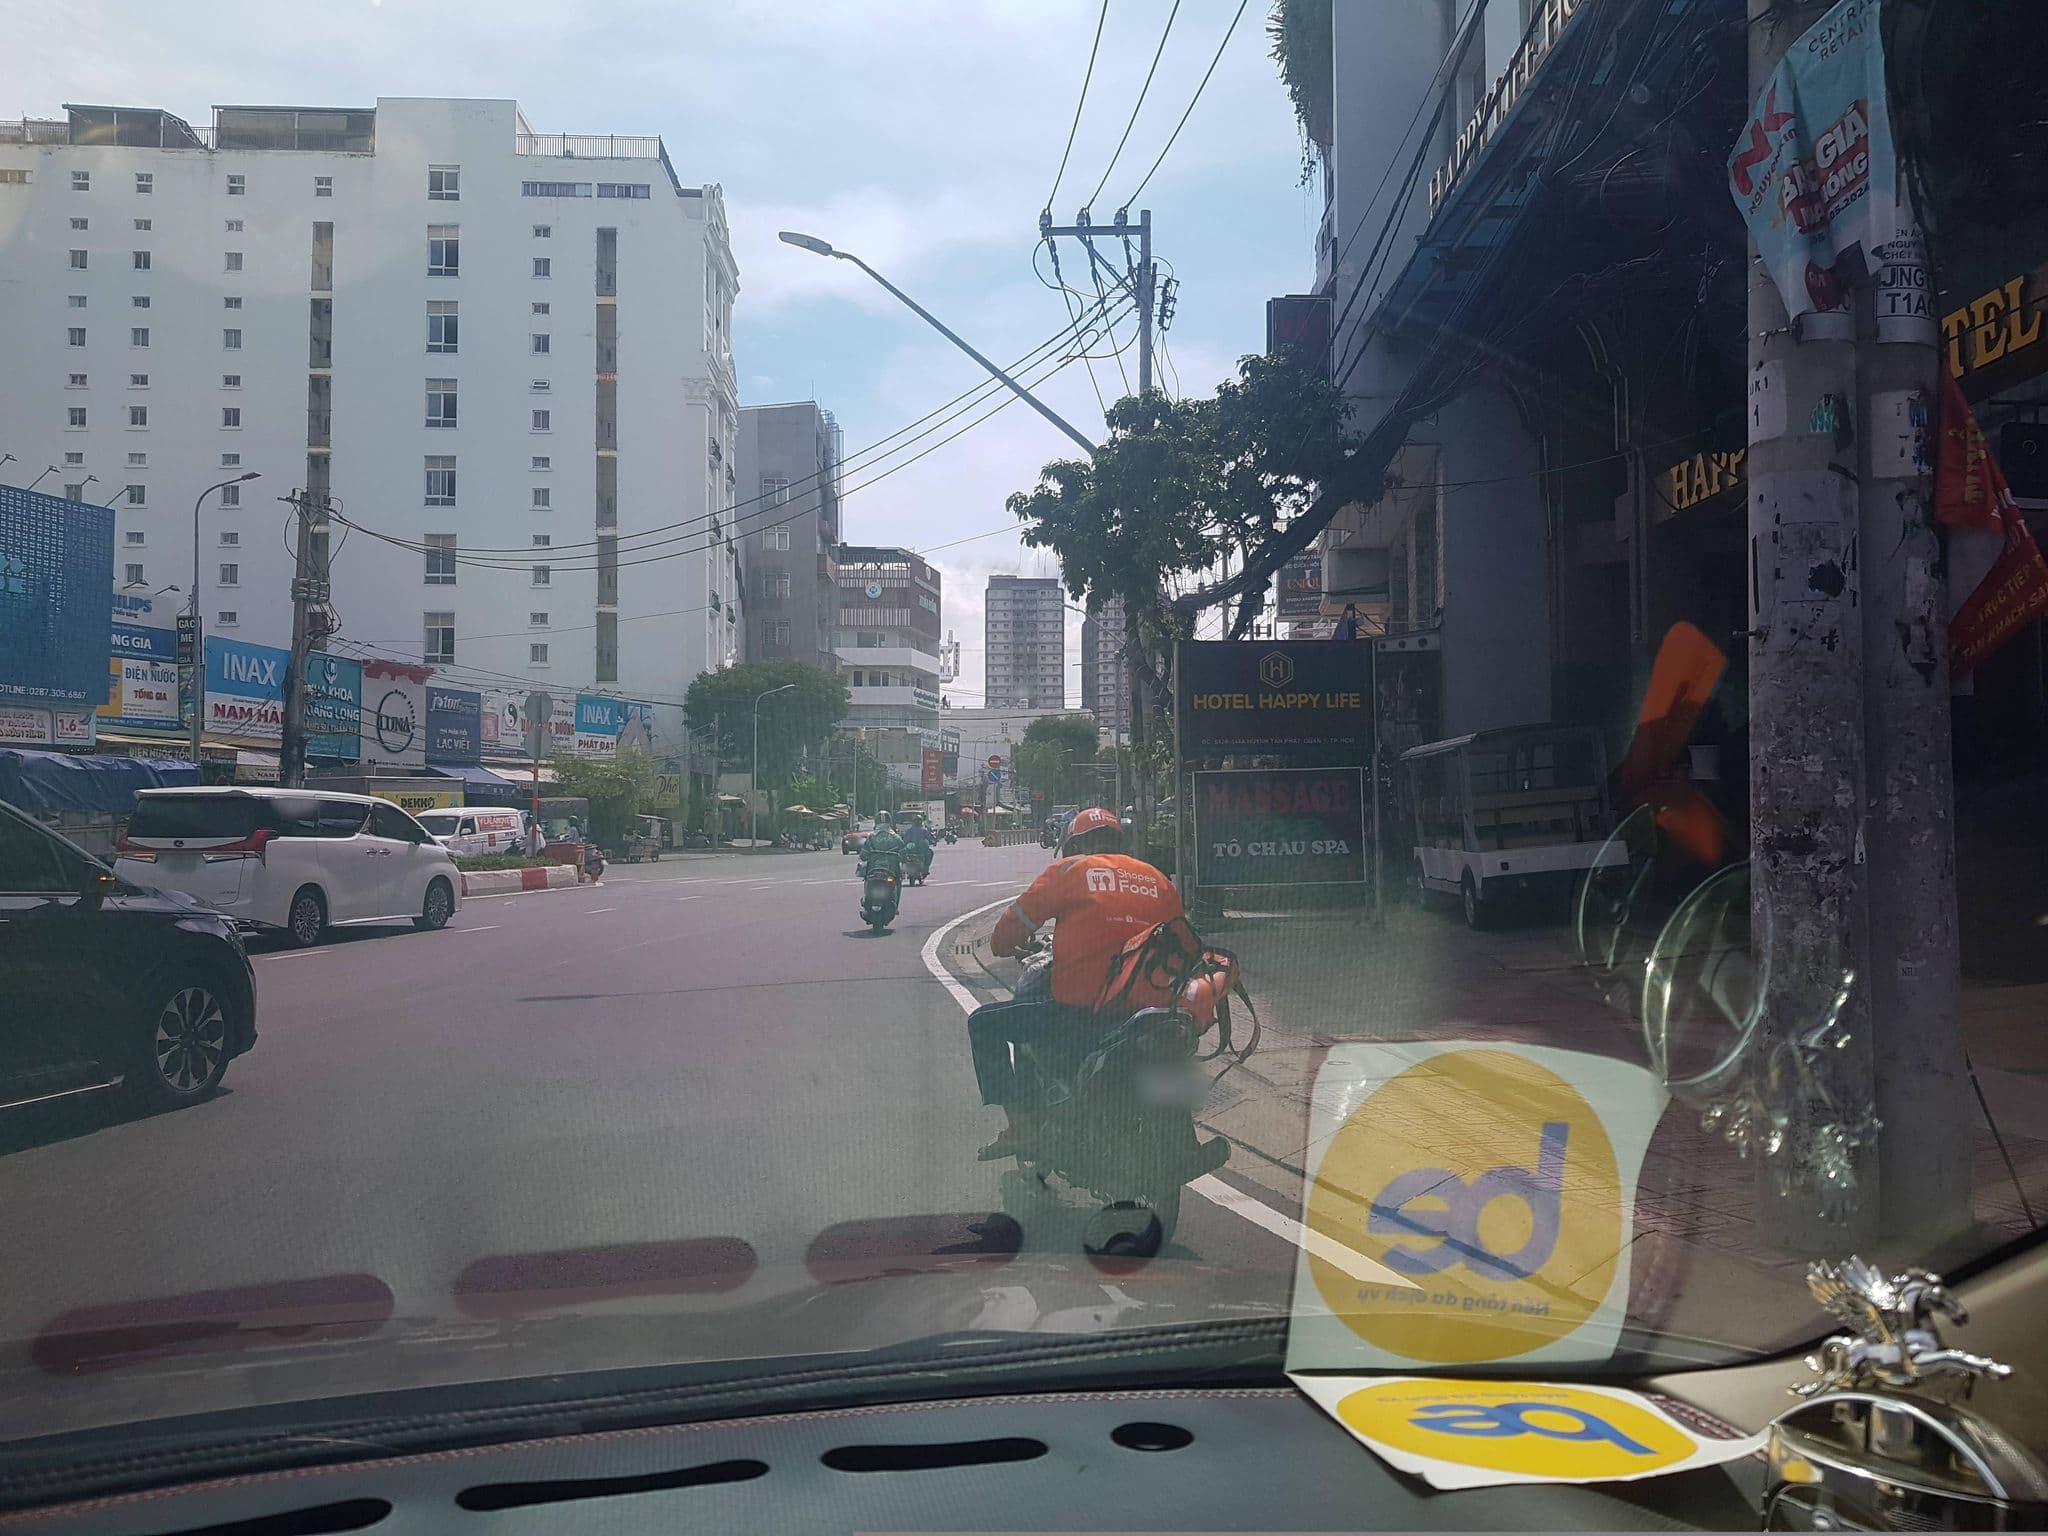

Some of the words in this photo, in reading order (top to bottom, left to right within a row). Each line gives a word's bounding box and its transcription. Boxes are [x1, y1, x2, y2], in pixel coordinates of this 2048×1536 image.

[1942, 275, 2042, 378] TEL
[132, 636, 151, 650] GIA
[223, 652, 277, 687] INAX
[1194, 694, 1254, 710] HOTEL
[1259, 693, 1321, 709] HAPPY
[1327, 693, 1361, 708] LIFE
[213, 703, 253, 720] NAM
[333, 706, 360, 722] LONG
[583, 704, 612, 726] INAX
[578, 738, 599, 750] PHÁT
[1213, 839, 1242, 857] TÔ
[1311, 840, 1350, 855] SPA
[1117, 868, 1157, 884] Shopee
[1119, 879, 1158, 898] Food
